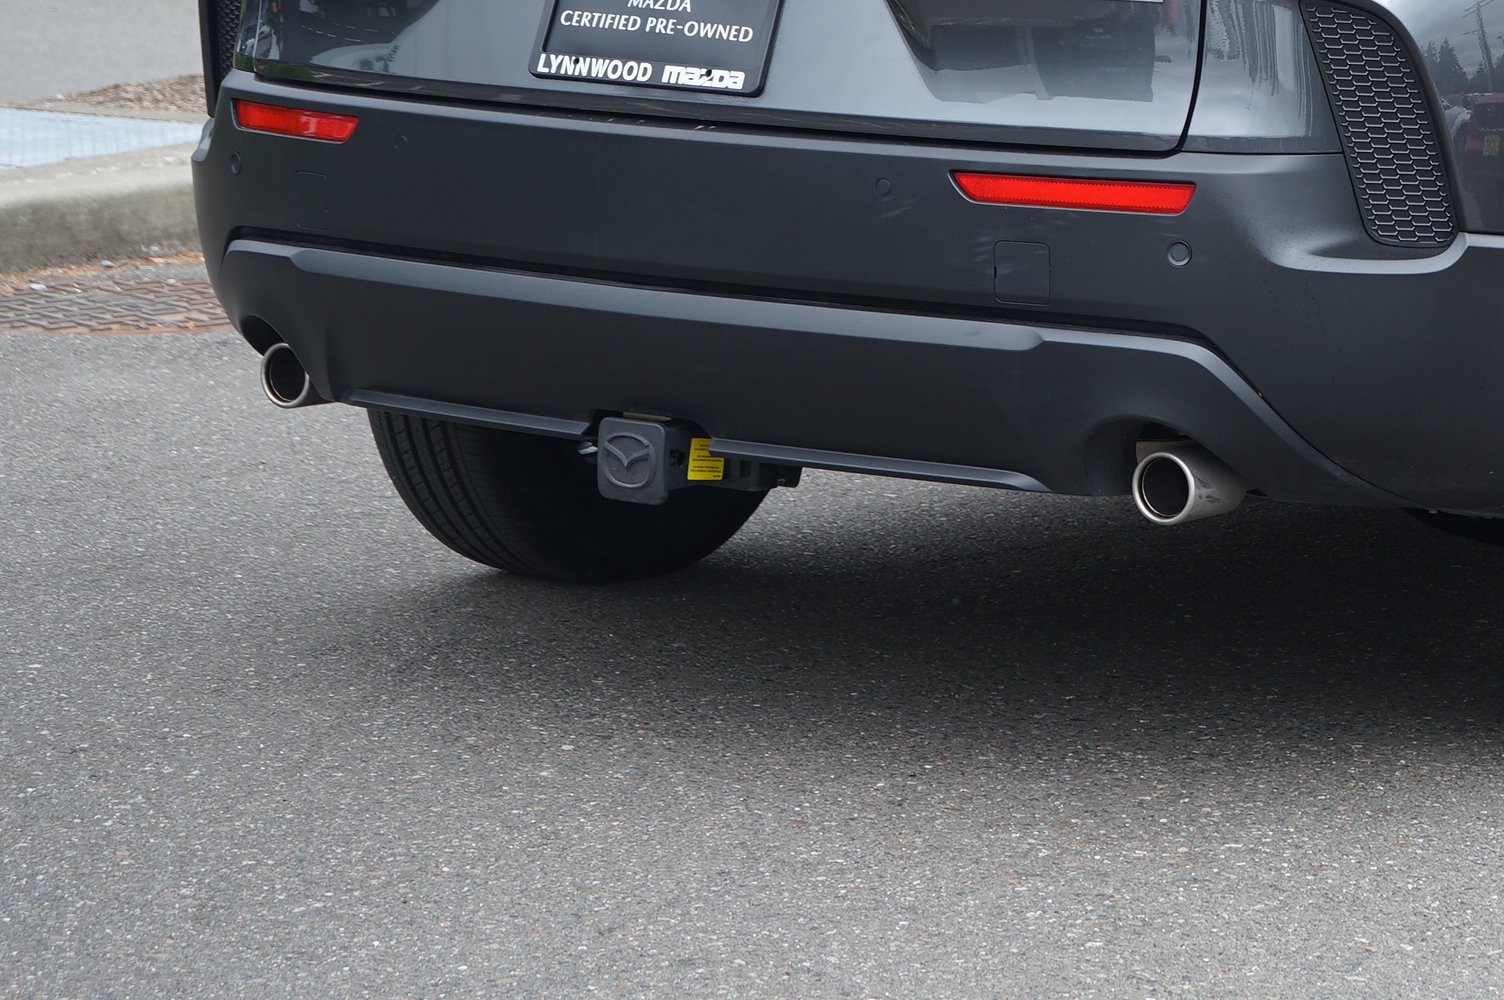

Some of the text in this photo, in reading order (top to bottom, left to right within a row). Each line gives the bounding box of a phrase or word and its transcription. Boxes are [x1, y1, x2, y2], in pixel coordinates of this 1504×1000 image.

[560, 10, 754, 43] CERTIFIED PRE-OWNED
[536, 53, 653, 82] LYNNWOOD
